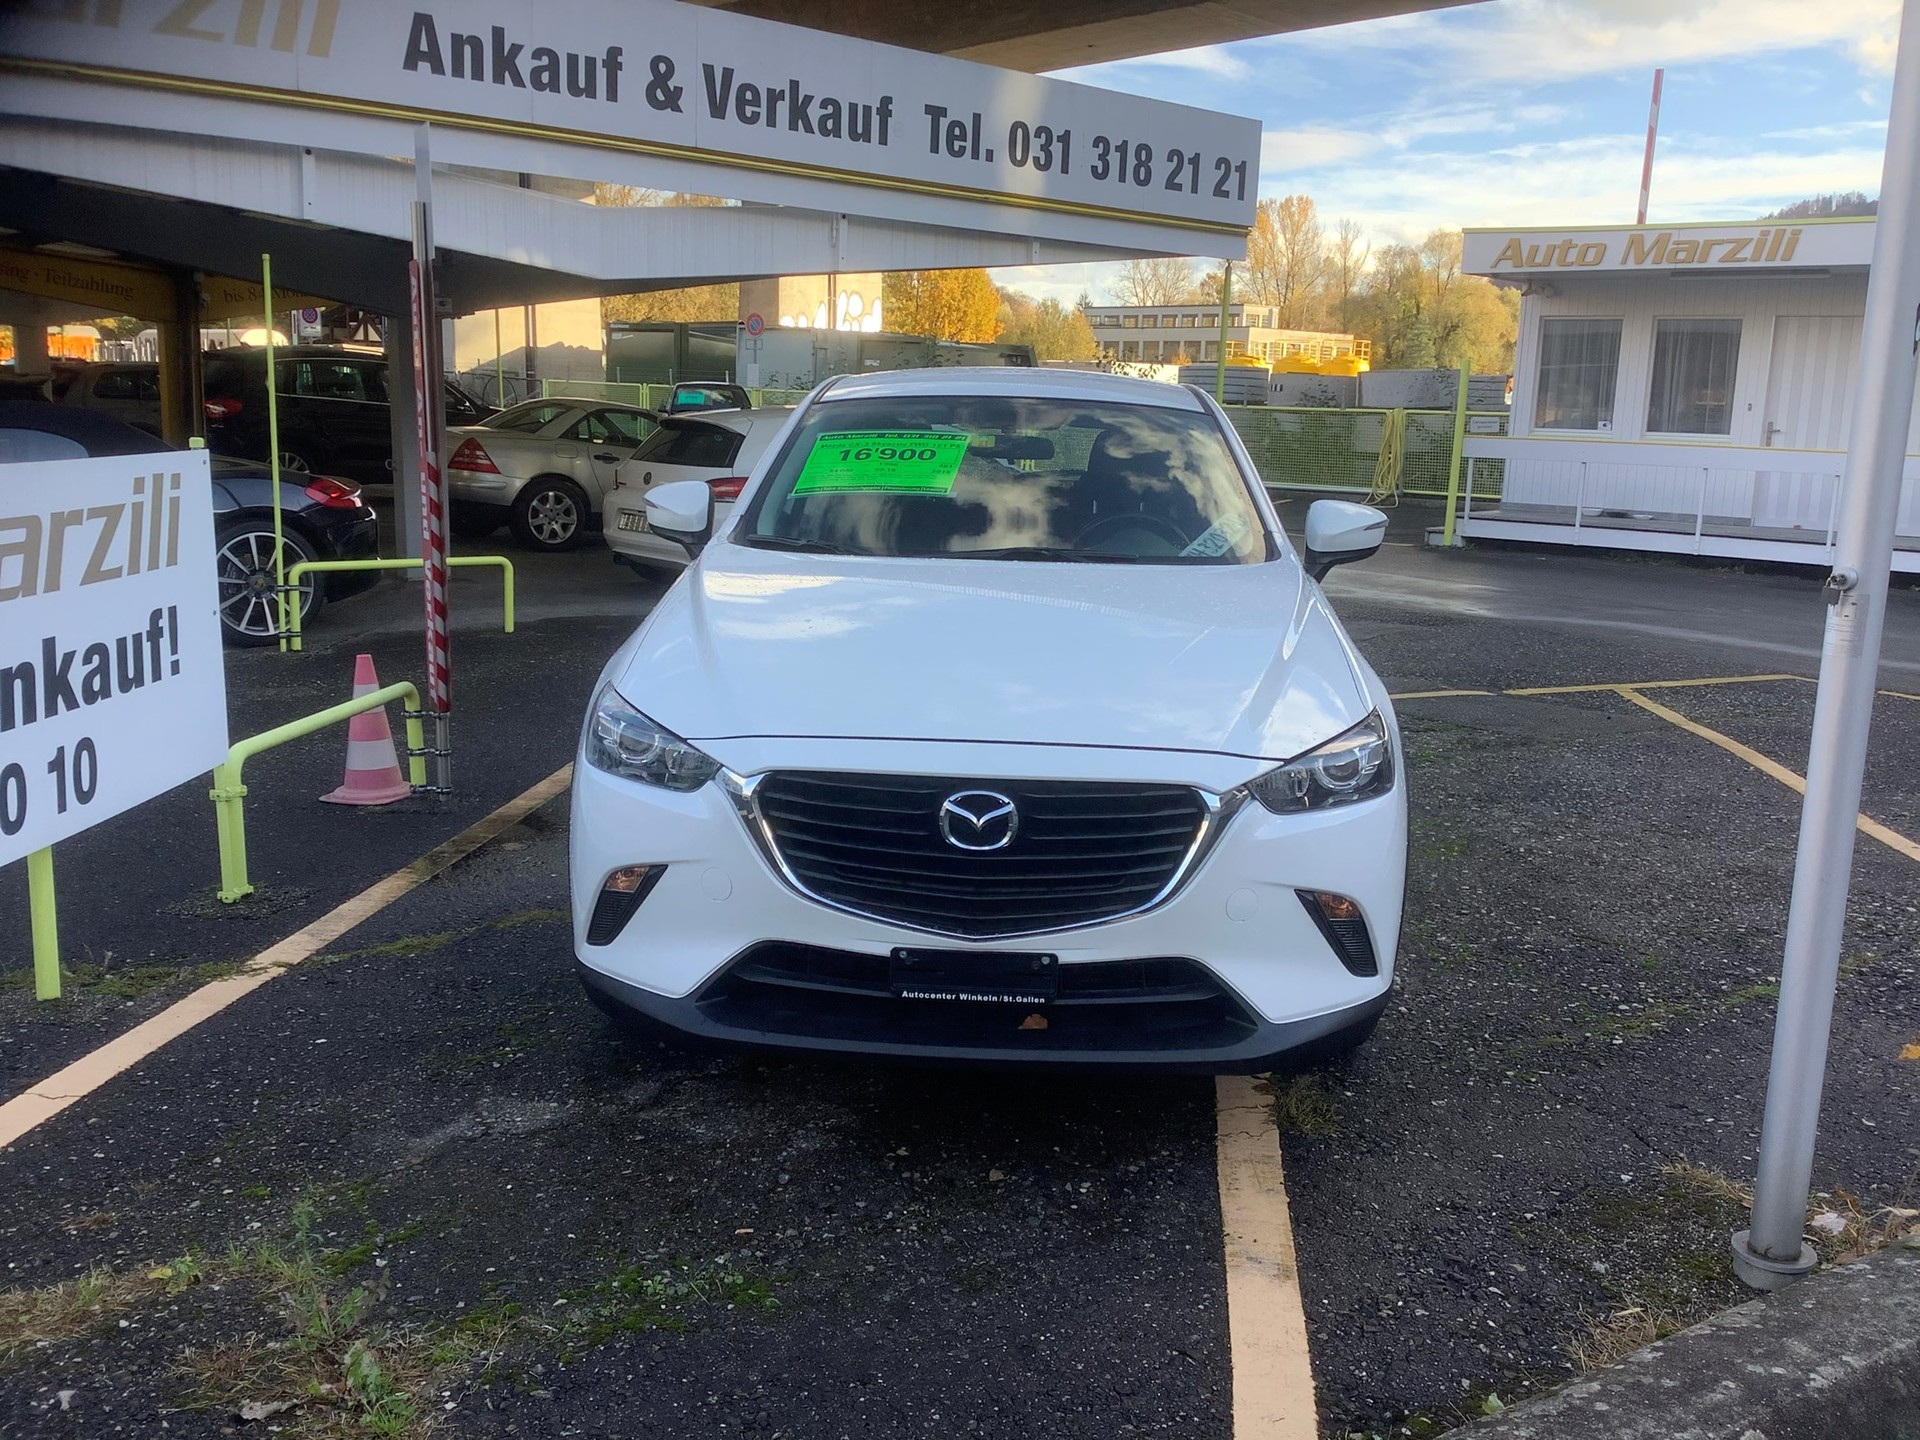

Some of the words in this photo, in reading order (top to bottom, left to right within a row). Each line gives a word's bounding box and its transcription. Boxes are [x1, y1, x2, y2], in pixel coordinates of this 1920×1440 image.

[402, 12, 623, 103] Ankauf
[645, 55, 683, 113] &
[702, 63, 892, 146] Verkauf
[924, 104, 994, 162] Tel.
[1008, 121, 1071, 174] 031
[1090, 135, 1153, 187] 318
[1164, 149, 1200, 194] 21
[1212, 157, 1247, 201] 21
[43, 267, 135, 301] Teilzahlung
[1491, 237, 1606, 268] Auto
[1619, 229, 1801, 264] Marzili
[839, 447, 937, 462] 16'900
[0, 472, 181, 602] arzili
[420, 472, 430, 540] und
[0, 605, 180, 733] nkauf!
[424, 558, 440, 704] Verkauf
[0, 762, 27, 836] 0
[47, 737, 98, 815] 10
[901, 990, 957, 1001] Autocenter
